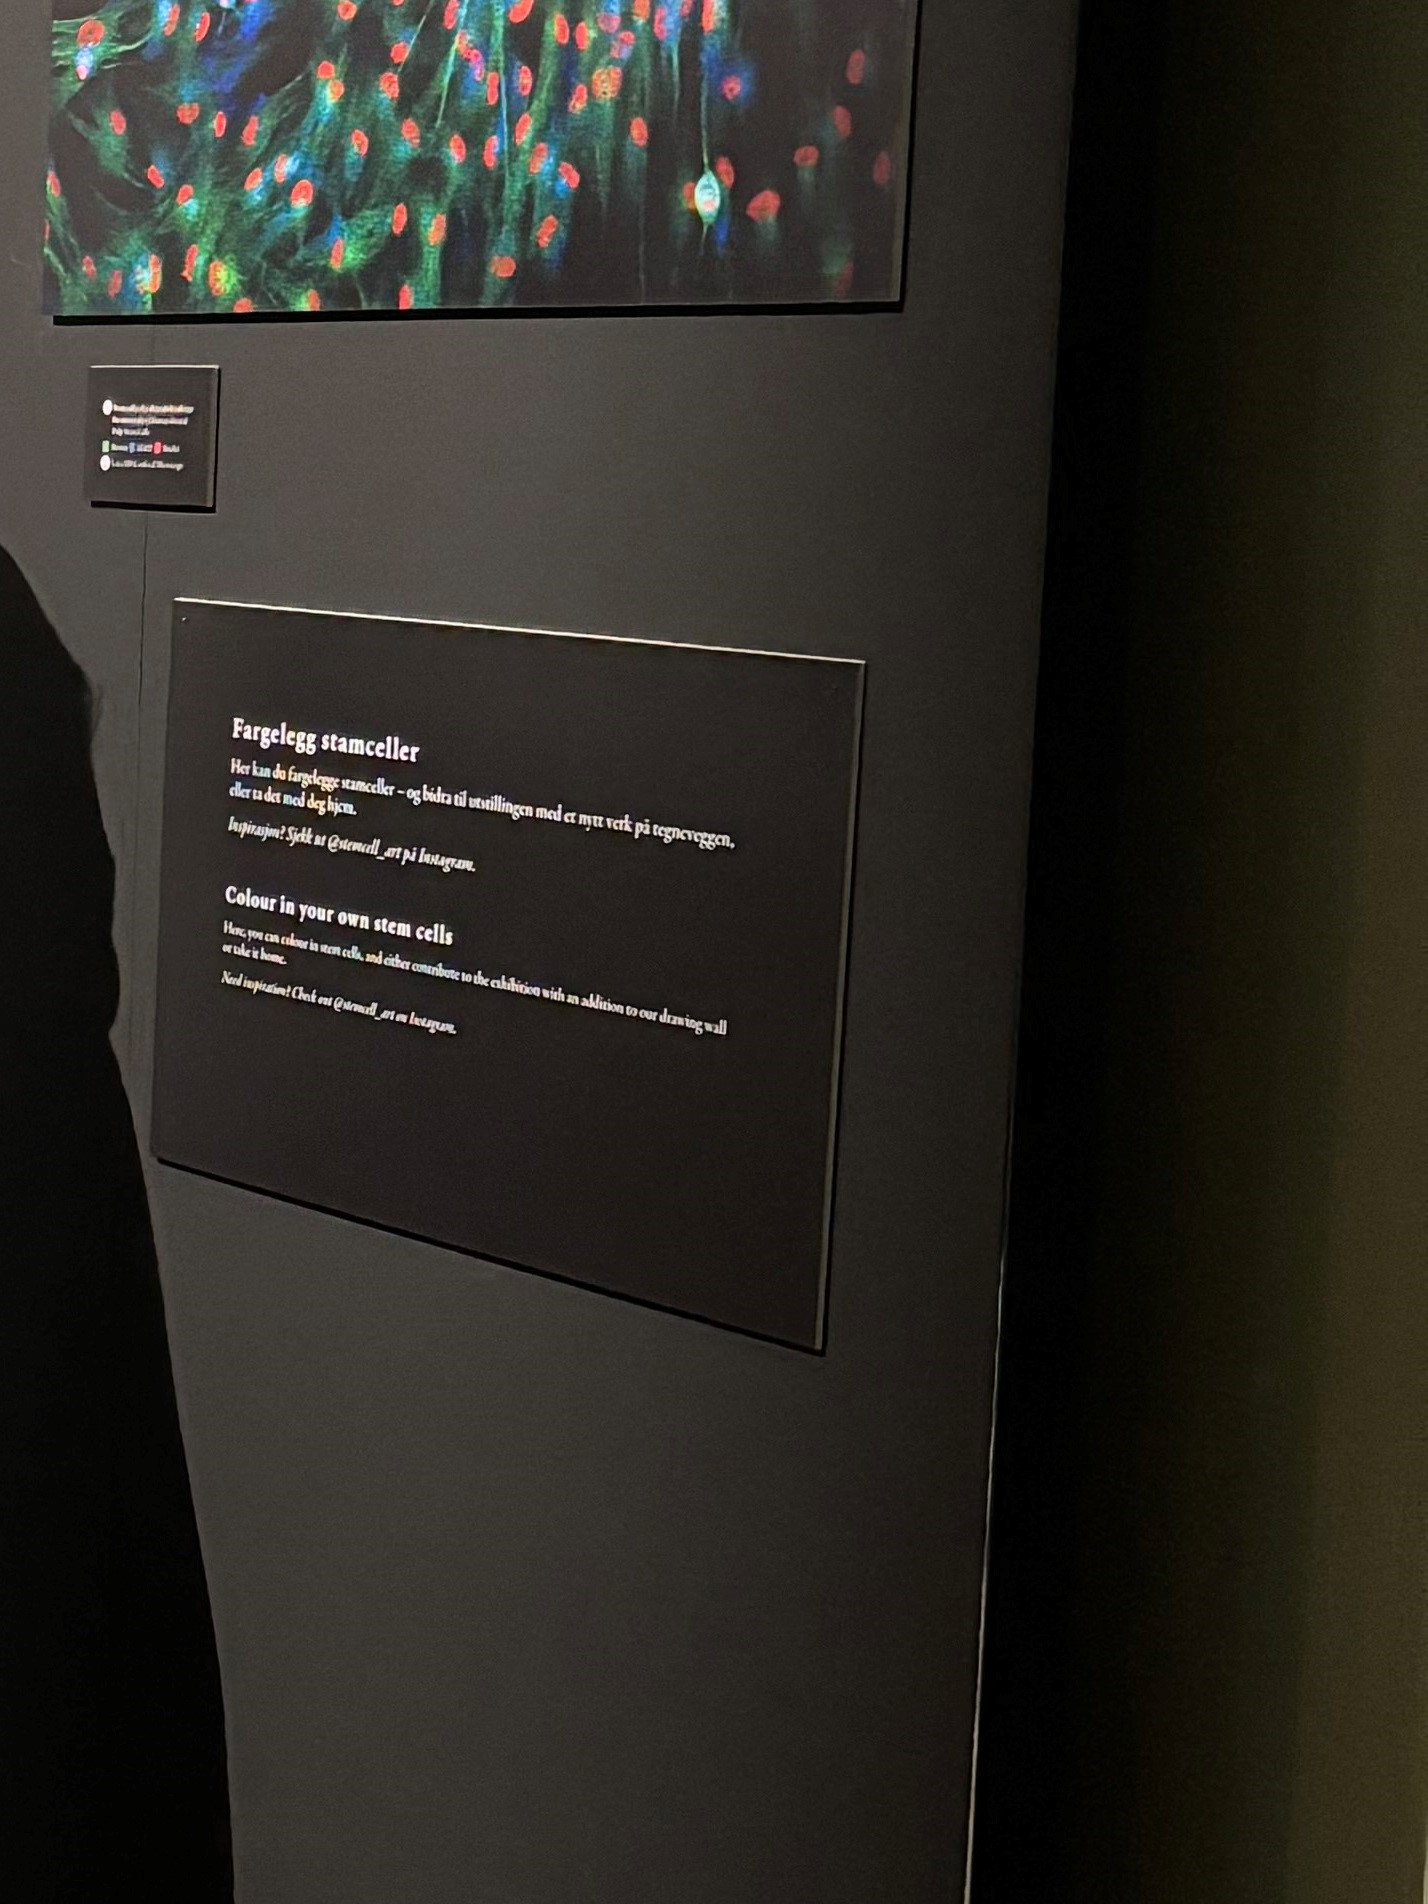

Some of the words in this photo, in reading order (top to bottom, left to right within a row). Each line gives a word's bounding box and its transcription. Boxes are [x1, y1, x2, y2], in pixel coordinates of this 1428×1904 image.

[232, 717, 317, 755] Fargelegg
[321, 732, 420, 763] stamceller
[229, 781, 251, 798] eller
[252, 789, 263, 801] ta
[264, 785, 281, 804] det
[282, 791, 305, 808] med
[307, 793, 326, 815] deg
[327, 795, 357, 816] hjem.
[230, 757, 251, 775] Her
[252, 760, 271, 778] kan
[272, 763, 286, 780] du
[287, 766, 340, 792] fargelegge
[341, 777, 395, 796] stamceller
[406, 788, 421, 806] og
[423, 784, 452, 805] bidra
[453, 790, 467, 807] til
[469, 794, 533, 820] utstillingen
[536, 804, 562, 822] med
[564, 811, 576, 824] et
[579, 813, 603, 831] nytt
[606, 814, 632, 832] verk
[634, 818, 650, 839] på
[228, 816, 286, 841] Inspirasjon?
[286, 826, 313, 847] Sjekk
[313, 835, 326, 846] ut
[327, 835, 402, 860] @stemcell_art
[401, 846, 417, 866] på
[418, 847, 476, 873] Instagram.
[225, 885, 278, 912] Colour
[279, 895, 295, 915] in
[299, 903, 335, 923] your
[337, 910, 370, 930] own
[373, 917, 411, 938] stem
[415, 923, 453, 945] cells
[222, 944, 233, 953] or
[233, 943, 250, 958] take
[252, 947, 259, 960] it
[260, 947, 287, 965] home.
[247, 929, 263, 942] you
[264, 933, 280, 943] can
[281, 932, 308, 950] colour
[309, 938, 318, 952] in
[320, 943, 341, 956] stem
[365, 950, 383, 965] and
[383, 953, 411, 971] either
[411, 962, 460, 981] contribute
[461, 972, 472, 983] to
[473, 970, 489, 987] the
[490, 975, 540, 997] exhibition
[542, 987, 565, 1003] with
[567, 994, 579, 1006] an
[580, 993, 624, 1015] addition
[626, 1005, 638, 1017] to
[639, 1009, 658, 1021] our
[659, 1008, 703, 1035] drawing
[704, 1019, 728, 1036] wall
[221, 970, 243, 986] Need
[291, 986, 317, 1003] Check
[317, 997, 333, 1007] out
[395, 1013, 408, 1023] on
[409, 1011, 457, 1034] Instagram.
